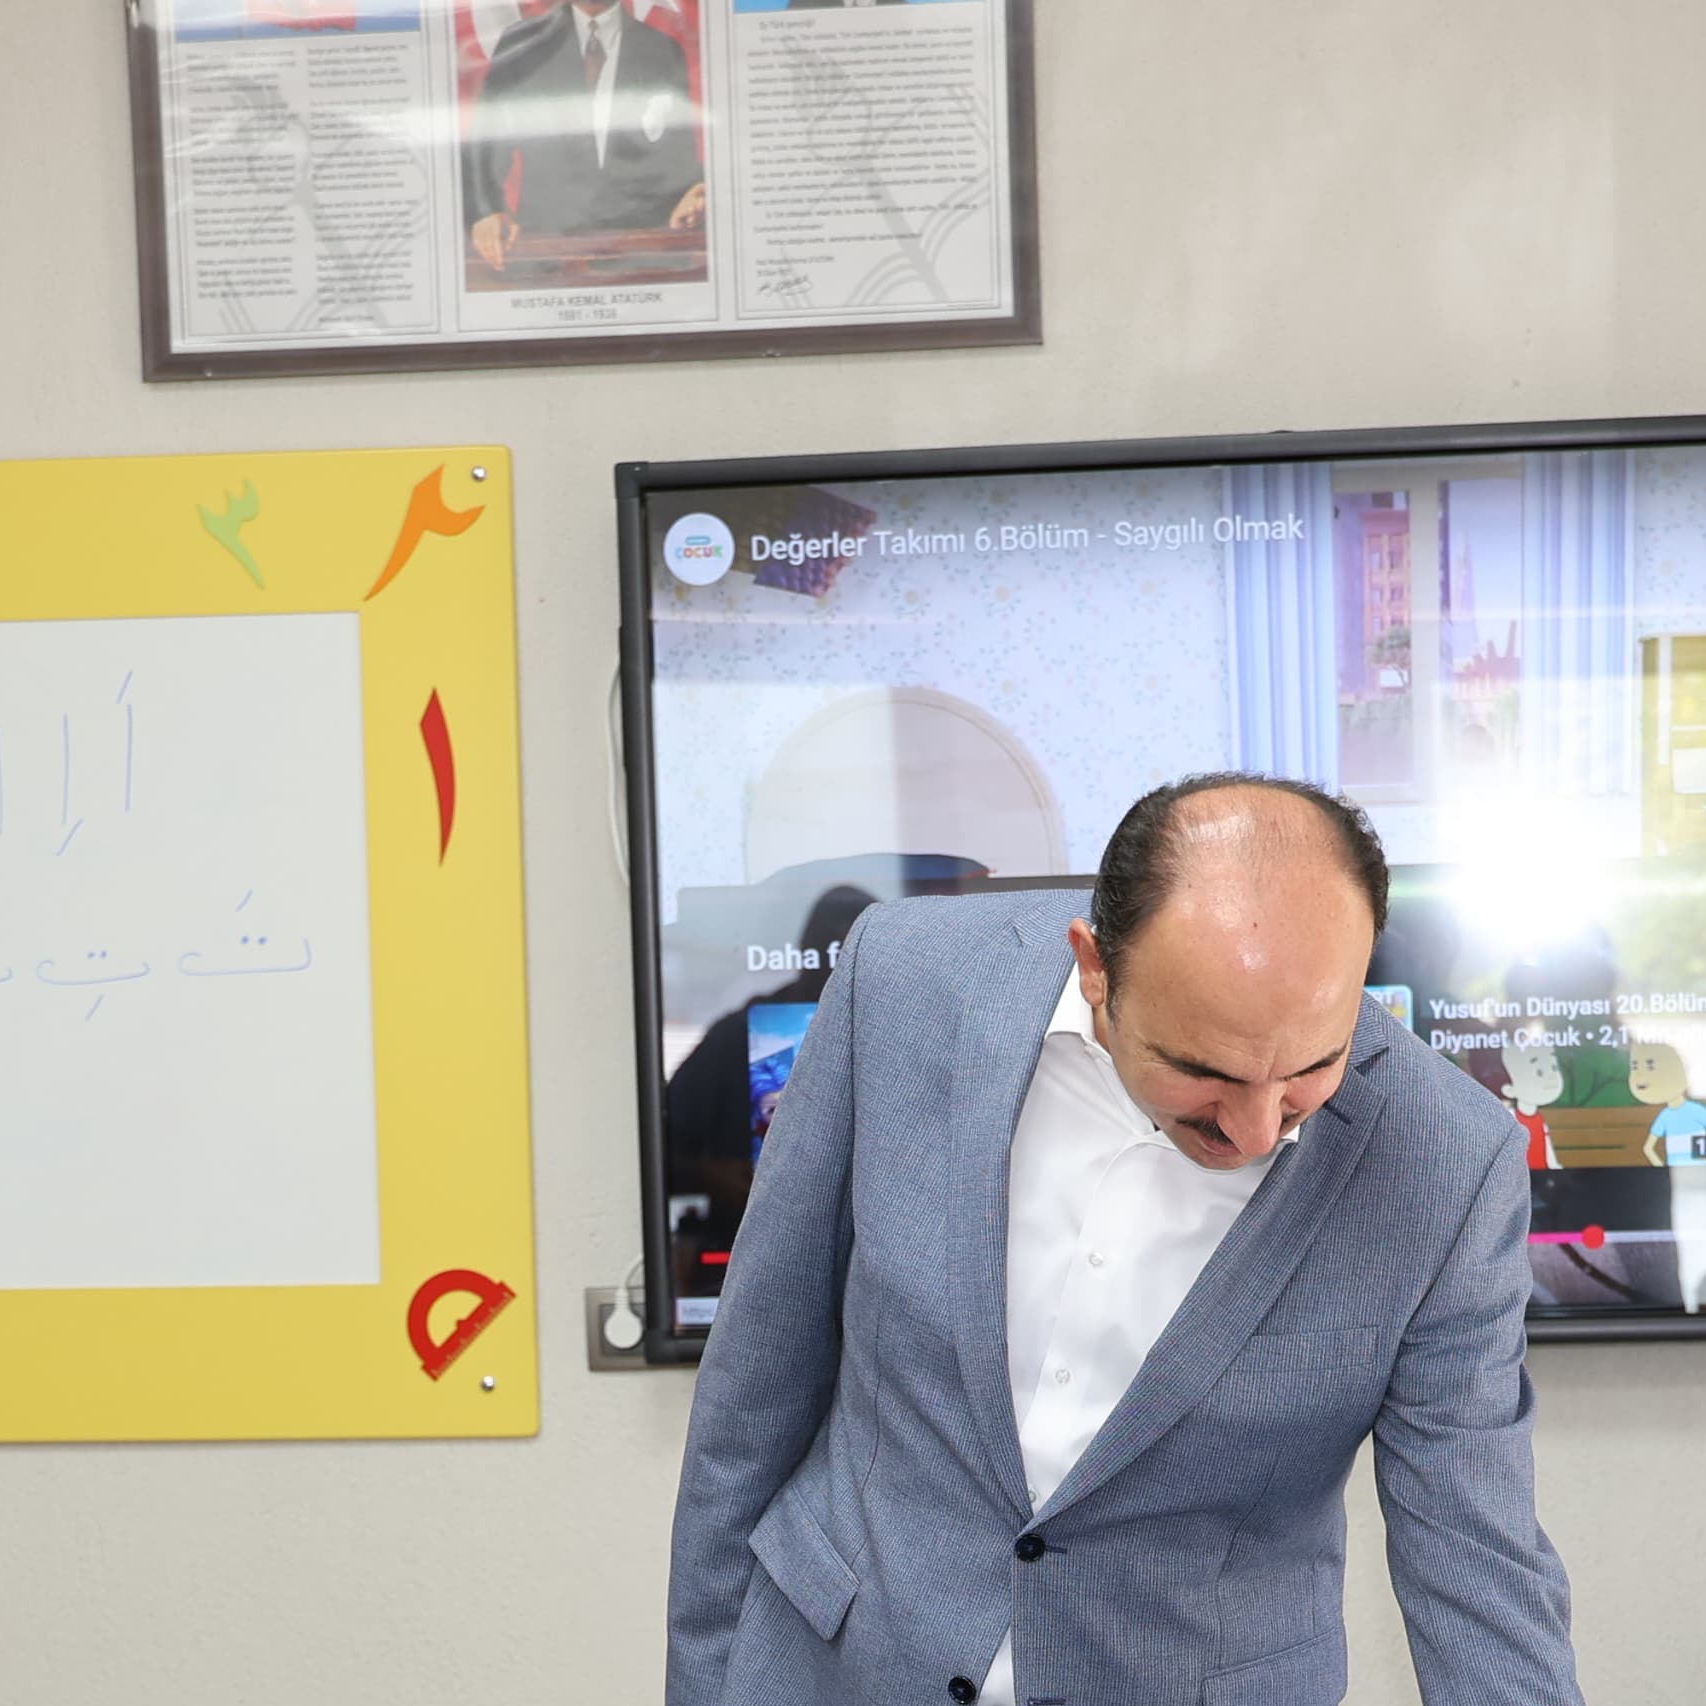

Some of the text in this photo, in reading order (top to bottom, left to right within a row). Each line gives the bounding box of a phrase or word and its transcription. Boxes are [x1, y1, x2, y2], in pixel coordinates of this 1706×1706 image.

[510, 297, 566, 309] MUSTAFA
[568, 295, 608, 306] KEMAL
[751, 530, 868, 566] Değerler
[873, 528, 966, 556] Takımı
[974, 523, 1089, 552] 6.Bölüm
[1114, 517, 1205, 551] Saygılı
[1213, 512, 1305, 543] Olmak
[747, 944, 820, 972] Daha
[1429, 997, 1521, 1021] Yusuf'un
[1526, 994, 1610, 1023] Dünyası
[1429, 1029, 1509, 1055] Diyanet
[1514, 1026, 1581, 1054] Çocuk
[1598, 1024, 1628, 1048] 2,1
